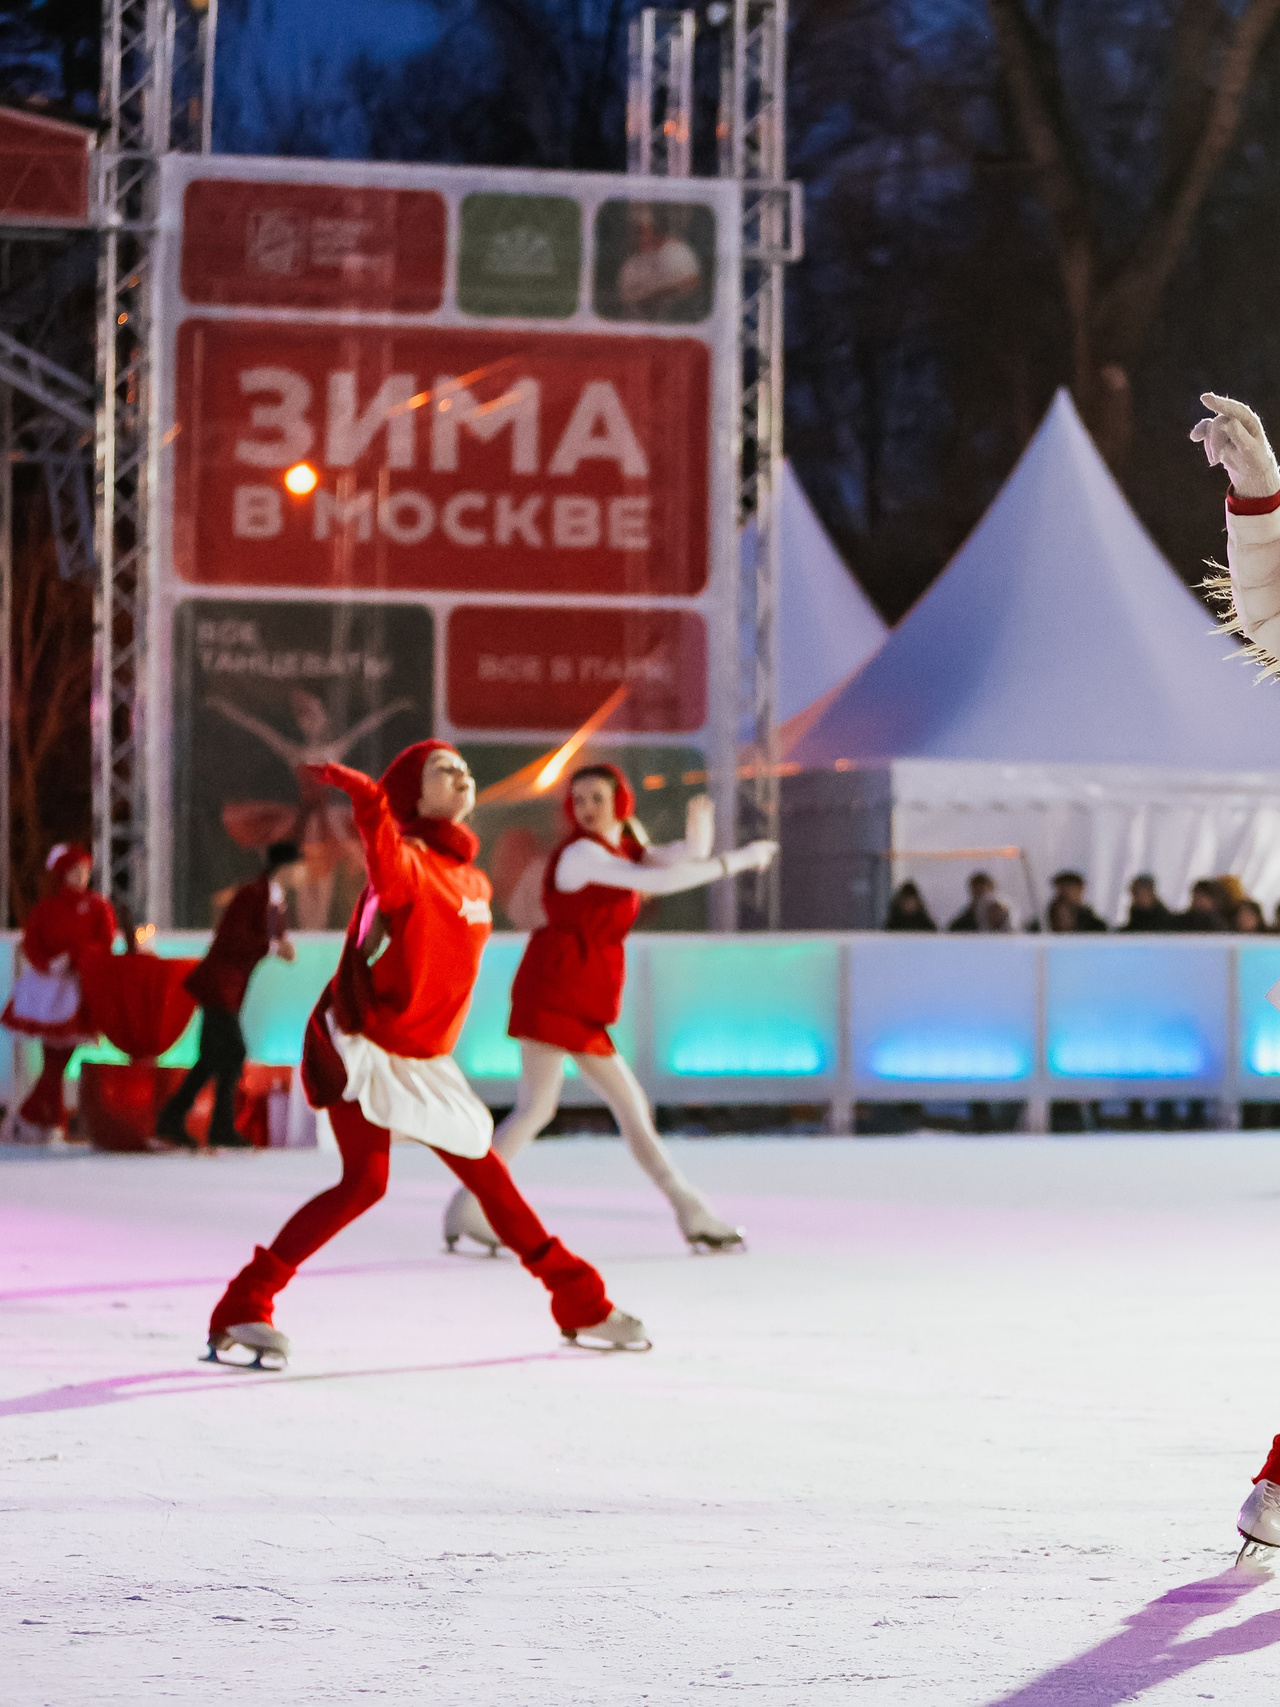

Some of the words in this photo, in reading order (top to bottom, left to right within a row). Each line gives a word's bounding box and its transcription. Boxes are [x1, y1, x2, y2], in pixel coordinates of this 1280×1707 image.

[233, 365, 650, 477] ЗИМА
[232, 484, 284, 539] В
[313, 489, 650, 550] МОСКВЕ
